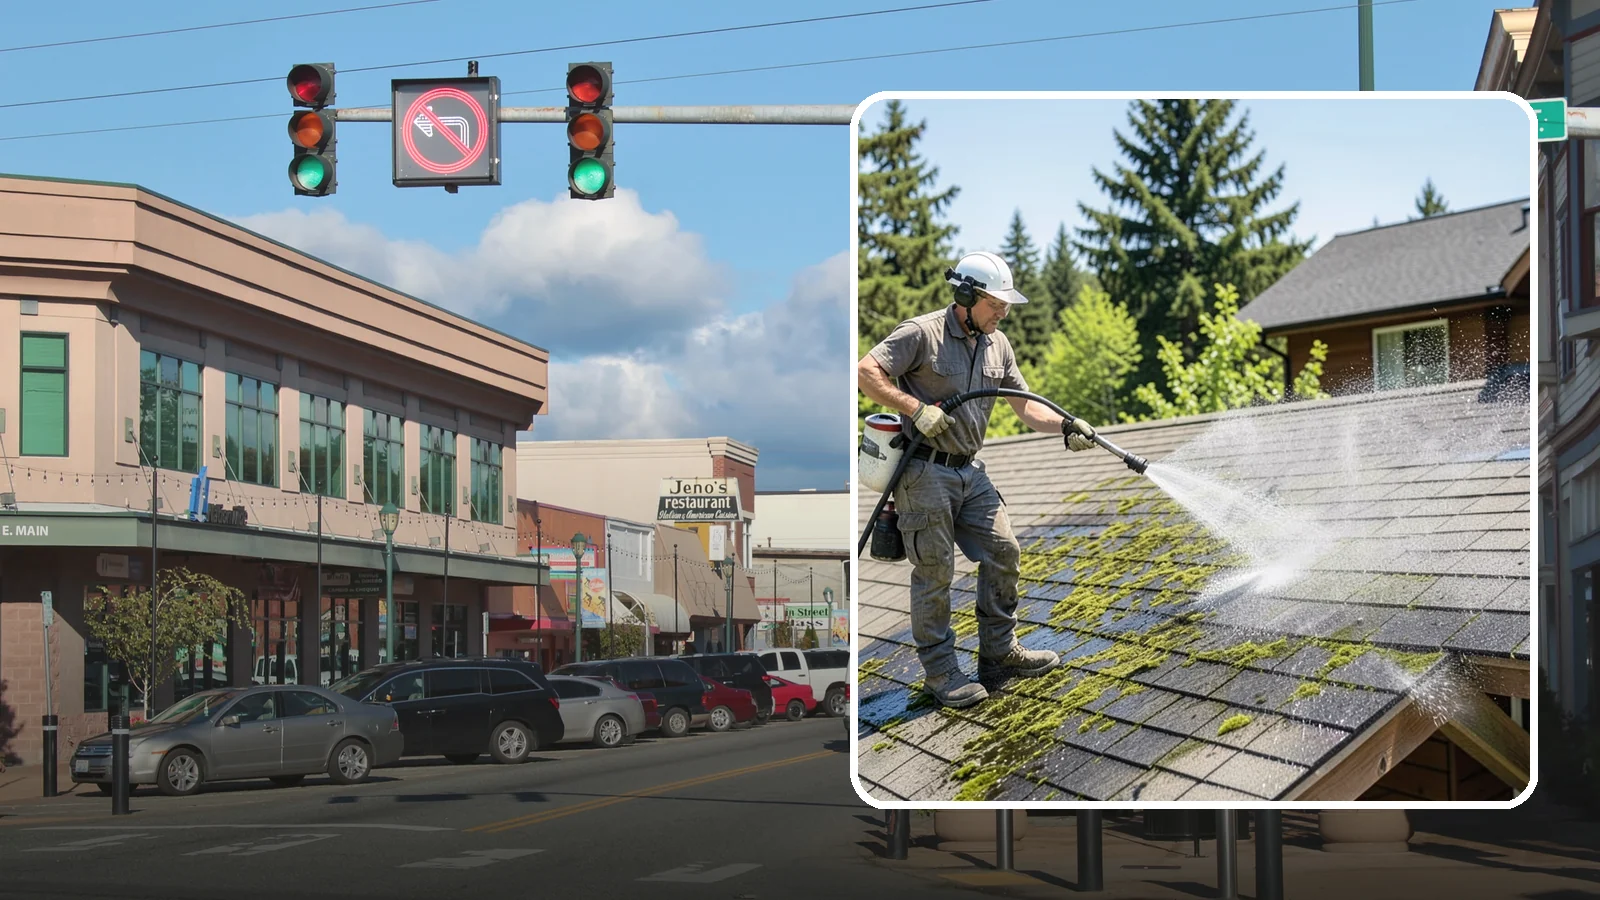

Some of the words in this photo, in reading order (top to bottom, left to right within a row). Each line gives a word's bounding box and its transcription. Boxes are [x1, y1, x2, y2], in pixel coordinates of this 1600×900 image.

[670, 480, 727, 494] Jeno's
[665, 496, 731, 509] restaurant
[686, 510, 714, 519] American
[715, 510, 737, 519] Cuisine
[2, 525, 13, 536] E.
[15, 525, 49, 536] MAIN
[797, 607, 828, 616] Street
[791, 619, 824, 627] lass
